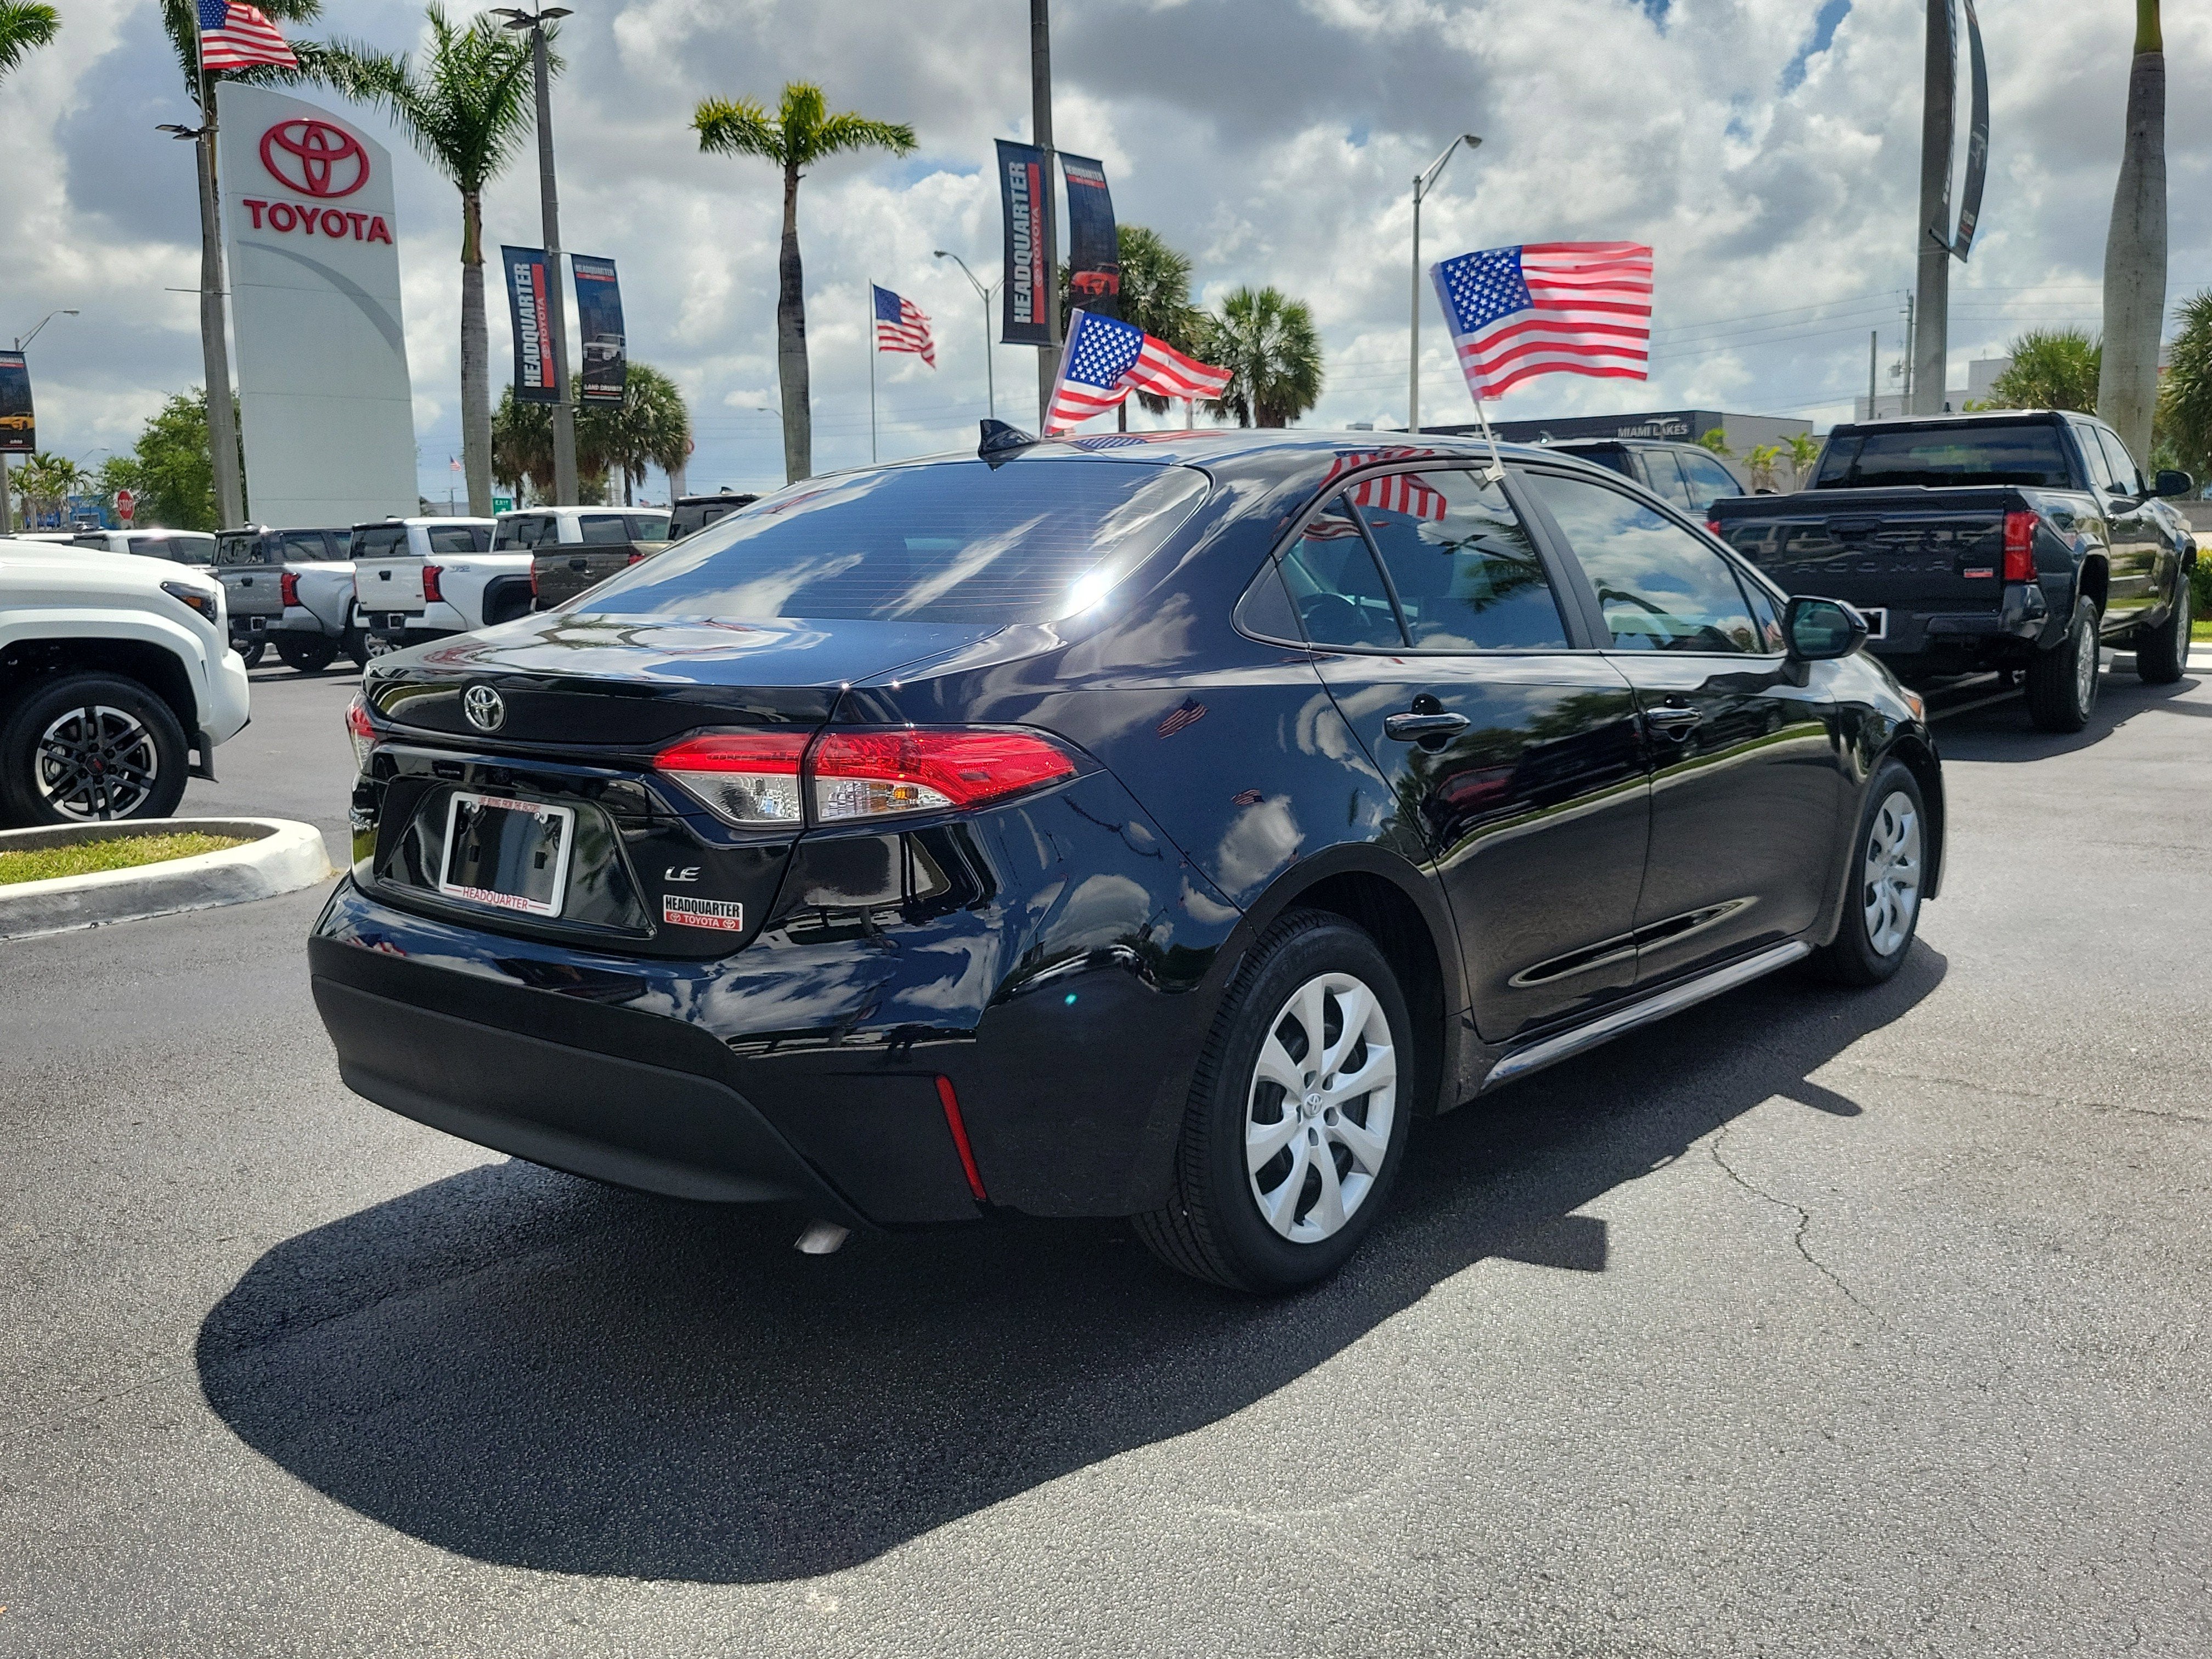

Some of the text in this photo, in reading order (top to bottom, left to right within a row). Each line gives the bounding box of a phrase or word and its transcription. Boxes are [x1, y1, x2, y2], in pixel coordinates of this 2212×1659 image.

[243, 199, 393, 245] TOYOTA
[1009, 162, 1032, 323] HEADQUARTER
[1031, 207, 1042, 266] TOYOTA
[514, 263, 541, 387] HEADQUARTER
[536, 298, 550, 345] TOYOTA
[1618, 423, 1689, 438] MIAMI LAKES
[119, 499, 133, 511] STOP
[664, 866, 701, 881] LE
[463, 887, 528, 910] HEADQUARTER
[665, 895, 740, 918] HEADQUARTER
[683, 915, 720, 927] TOYOTA
